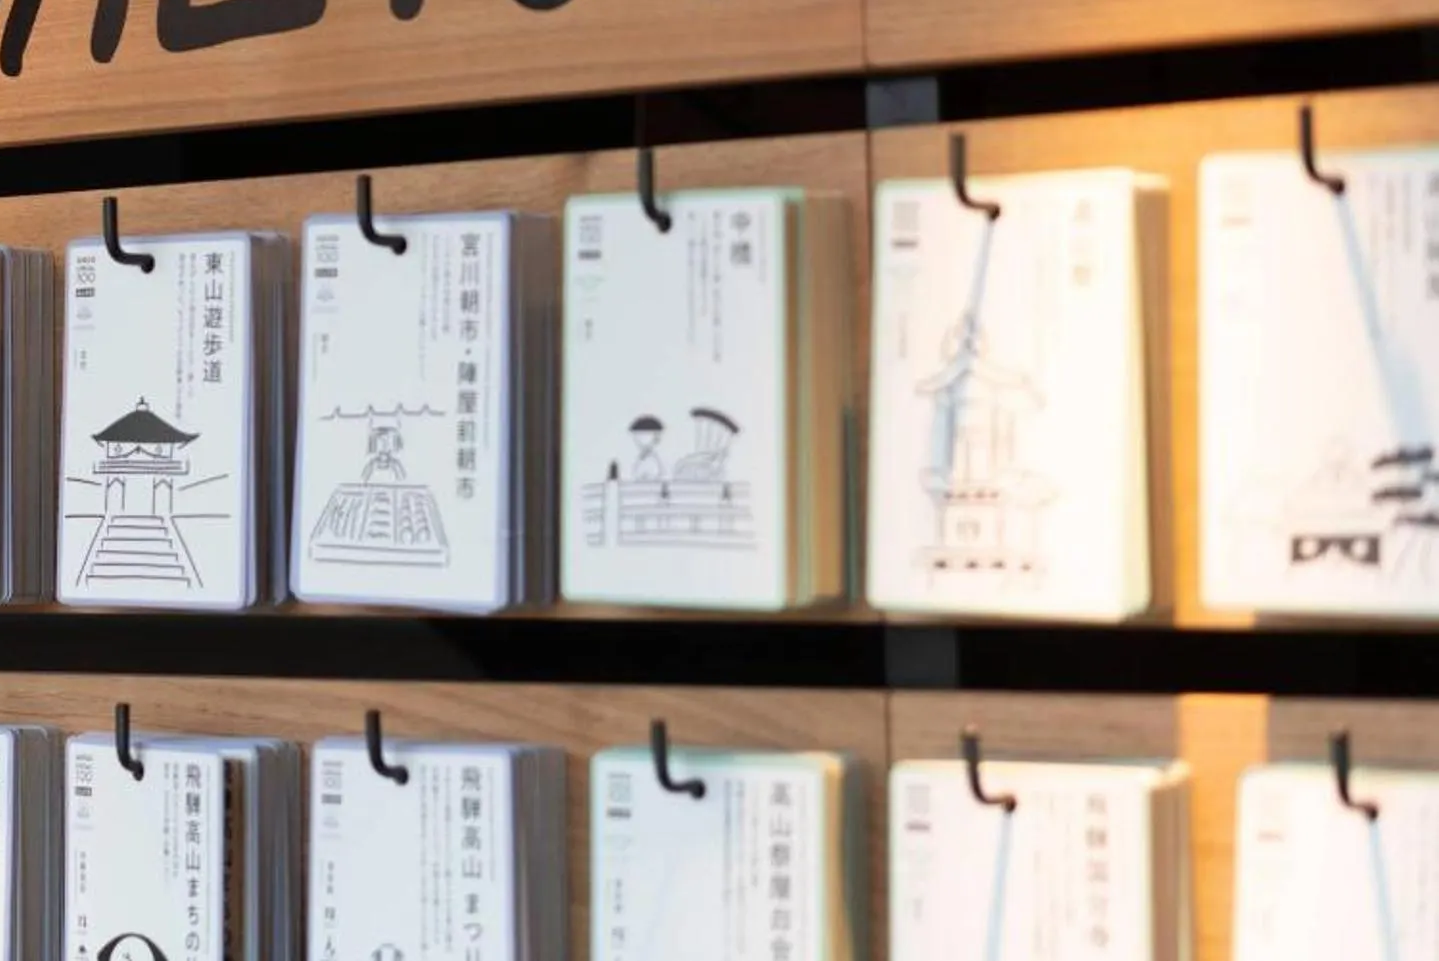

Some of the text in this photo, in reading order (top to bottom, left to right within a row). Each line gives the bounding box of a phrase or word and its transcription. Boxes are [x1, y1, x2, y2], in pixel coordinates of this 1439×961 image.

[203, 252, 224, 384] 東山遊歩道
[185, 762, 203, 961] 飛騨高山まちの
